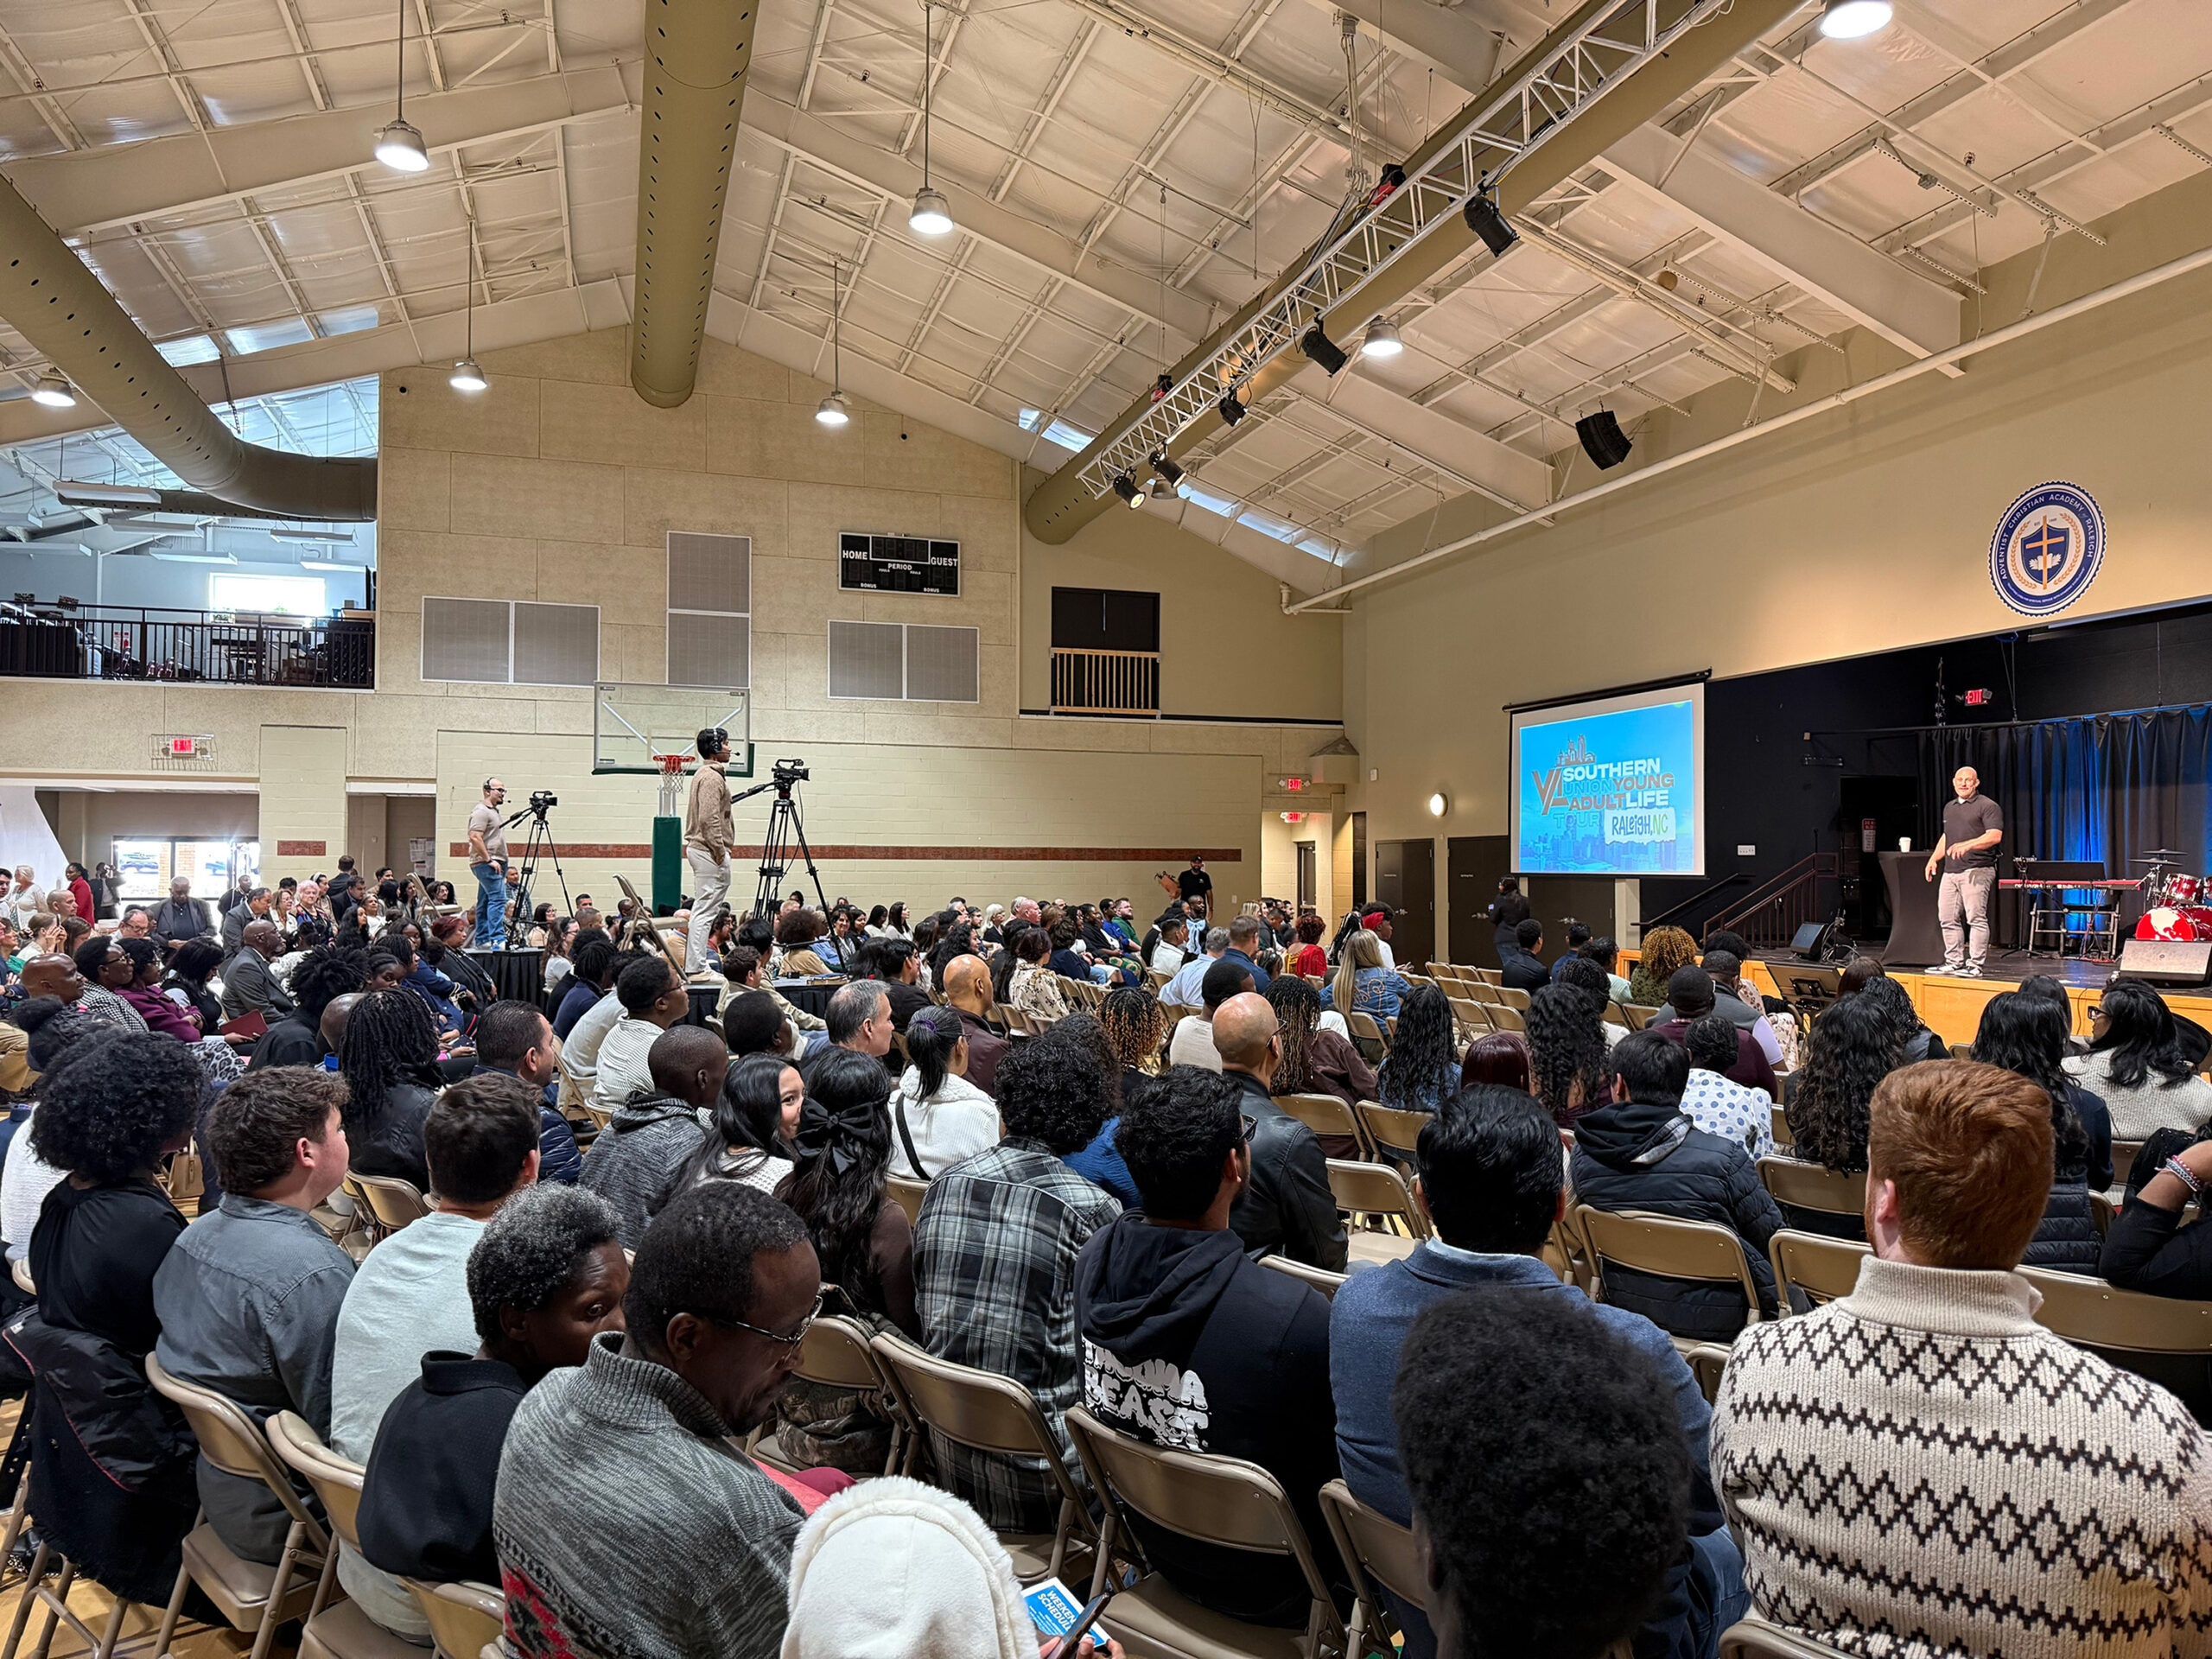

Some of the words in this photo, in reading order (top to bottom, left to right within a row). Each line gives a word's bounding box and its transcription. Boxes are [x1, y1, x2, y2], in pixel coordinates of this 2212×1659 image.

[1999, 533, 2011, 580] ADVENTIST
[2008, 495, 2045, 529] CHRISTIAN
[2049, 493, 2085, 512] ACADEMY
[2085, 518, 2096, 558] RALEIGH
[842, 550, 868, 560] HOME
[931, 556, 958, 567] GUEST
[887, 563, 912, 571] PERIOD
[1967, 690, 1982, 703] EXIT
[1562, 758, 1661, 781] SOUTHERN
[1288, 779, 1301, 790] EXIT
[1565, 779, 1614, 795] UNION
[1613, 773, 1675, 791] YOUNG
[1568, 793, 1626, 810] ADULT
[1625, 791, 1669, 809] LIFE
[1554, 811, 1600, 828] TOUR
[1653, 814, 1669, 836] NC
[1084, 1363, 1210, 1453] BEAST
[1038, 1593, 1071, 1631] SCHEDUL
[1047, 1590, 1077, 1624] WEEKEN
